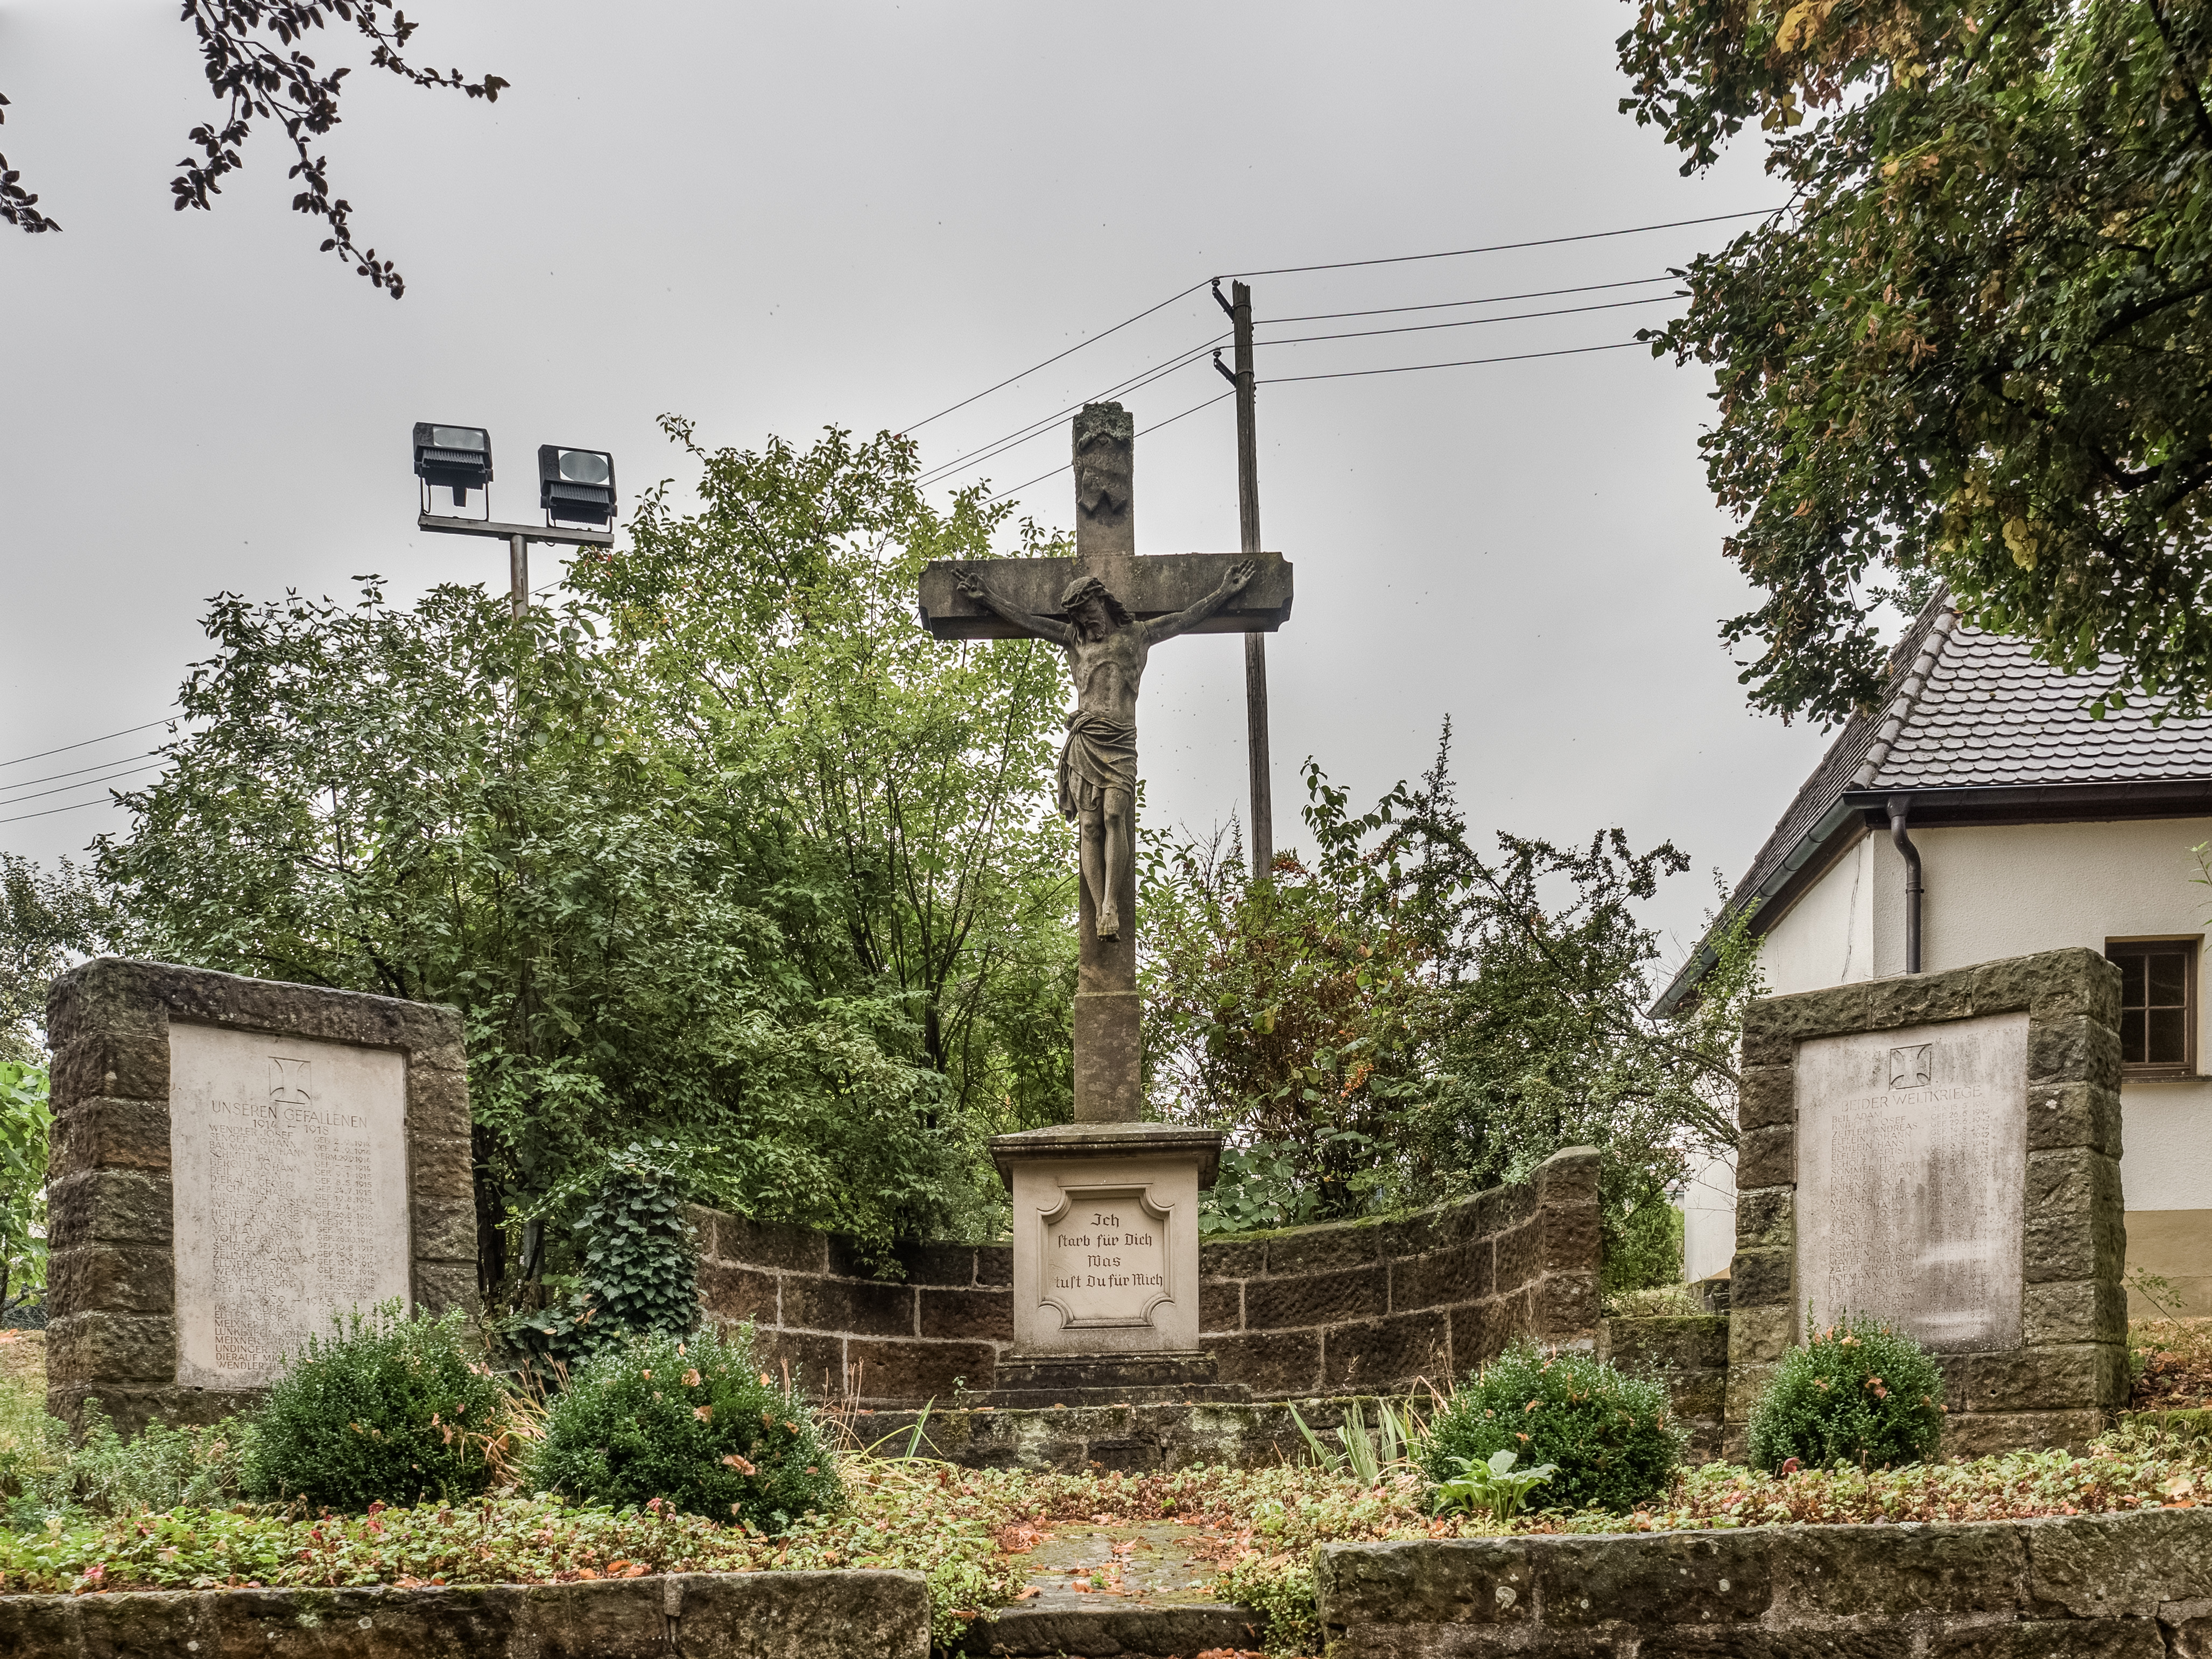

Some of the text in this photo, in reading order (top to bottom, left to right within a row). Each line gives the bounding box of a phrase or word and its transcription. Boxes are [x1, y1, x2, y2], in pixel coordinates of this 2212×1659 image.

[1841, 1085, 1981, 1112] BEIDER WELTKRIEGE
[212, 1099, 367, 1129] UNSEREN GEFALLENEN
[1832, 1111, 1882, 1123] BEIL ADAM
[252, 1118, 278, 1130] 1914
[304, 1124, 329, 1135] 1918
[1877, 1115, 1906, 1126] JOSEF
[208, 1124, 257, 1136] WENDLER
[260, 1128, 293, 1140] JOSEF
[1832, 1127, 1869, 1138] ZEITLER
[1873, 1122, 1918, 1134] ANDREAS
[209, 1132, 249, 1144] SENGER
[253, 1136, 295, 1148] JOHANN
[1831, 1135, 1865, 1146] ELFLEIN
[1870, 1131, 1911, 1142] JOHANN
[1877, 1139, 1904, 1149] HANS
[209, 1140, 307, 1157] BAUMANN JOHANN
[1831, 1150, 1865, 1161] ELFLEIN
[210, 1157, 251, 1169] HEROLD
[257, 1162, 300, 1174] JOHANN
[1831, 1158, 1866, 1169] SCHOLZ
[1831, 1165, 1874, 1176] SOMMER
[1879, 1161, 1919, 1171] EDUARD
[238, 1169, 280, 1180] JOHANN
[1876, 1168, 1918, 1179] JOHANN
[210, 1174, 253, 1186] DIERAUF
[258, 1178, 293, 1189] GEORG
[210, 1183, 239, 1193] KOCH
[248, 1186, 291, 1197] MICHAEL
[277, 1197, 307, 1207] JOSEF
[212, 1216, 240, 1226] VOLL
[244, 1219, 293, 1230] ANDREAS
[272, 1213, 304, 1223] JOSEF
[1090, 1213, 1119, 1228] Ich
[212, 1233, 238, 1243] VOLL
[245, 1236, 282, 1246] GEORG
[269, 1229, 304, 1240] GEORG
[1097, 1234, 1119, 1248] für
[1125, 1233, 1152, 1248] Dich
[213, 1259, 249, 1269] ELLNER
[253, 1261, 289, 1271] GEORG
[1088, 1255, 1121, 1267] Was
[1829, 1257, 1862, 1266] MAYER
[1868, 1253, 1918, 1263] FRIEDRICH
[1858, 1262, 1900, 1272] JOHANN
[1086, 1275, 1106, 1287] Du
[1108, 1274, 1130, 1288] für
[1132, 1273, 1163, 1288] Mich
[1829, 1272, 1878, 1281] HOFMANN
[262, 1278, 296, 1288] GEORG
[306, 1297, 334, 1307] 1945
[255, 1312, 290, 1321] GEORG
[215, 1319, 258, 1328] MEIXNER
[215, 1336, 259, 1345] MEIXNER
[215, 1344, 267, 1353] UNDINGER
[216, 1352, 257, 1361] DIERAUF
[216, 1361, 264, 1370] WENDLER
